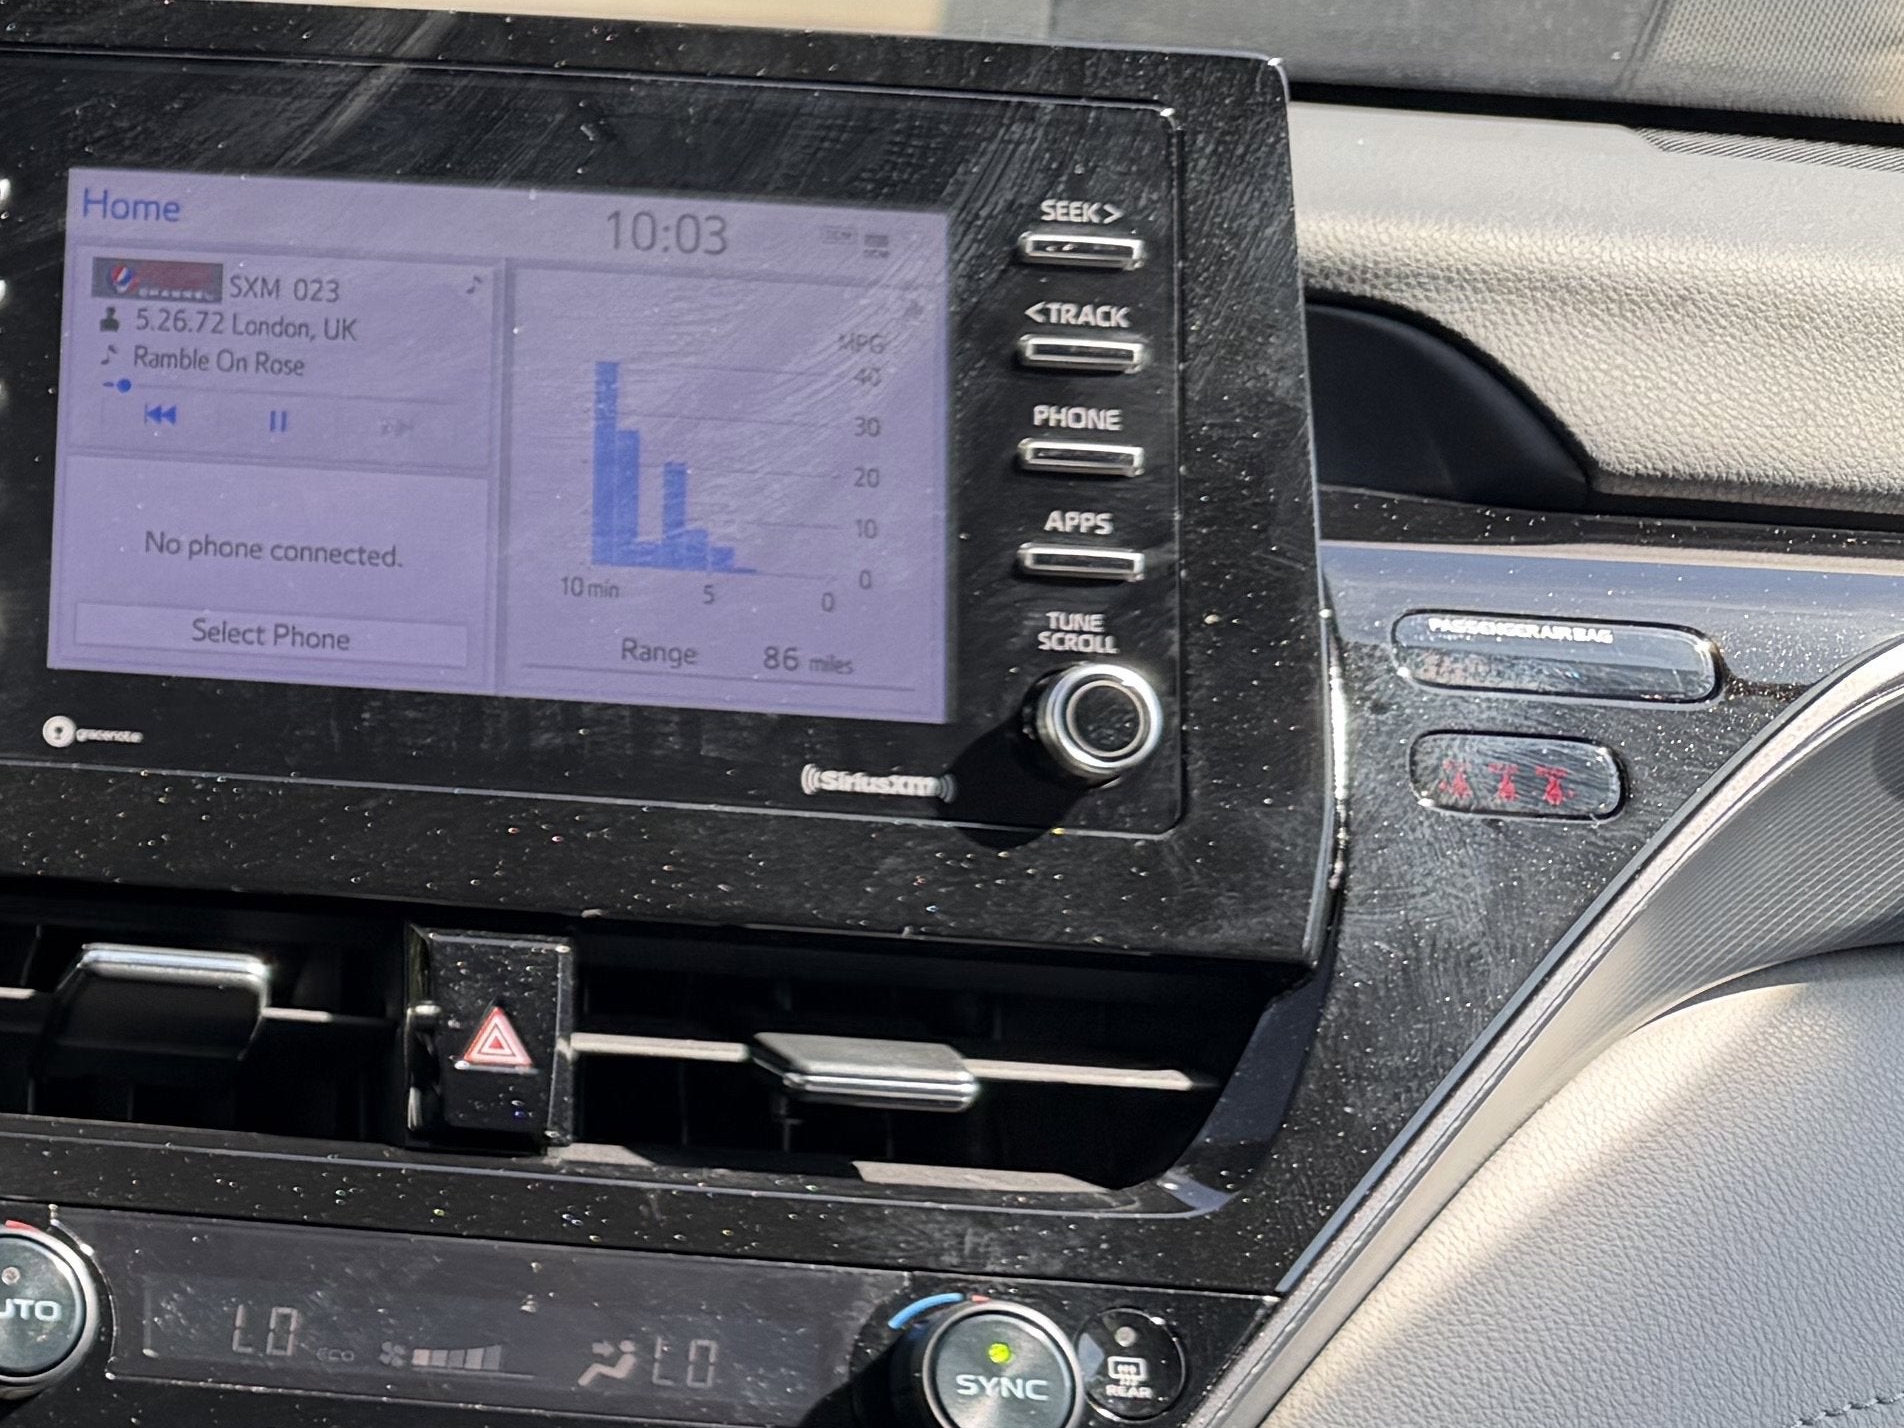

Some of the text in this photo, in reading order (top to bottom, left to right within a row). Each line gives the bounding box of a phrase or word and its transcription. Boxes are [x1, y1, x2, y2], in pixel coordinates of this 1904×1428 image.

[82, 187, 182, 223] Home
[606, 210, 730, 256] 10:03
[229, 275, 342, 304] SXM 023
[134, 306, 358, 343] 5.26.72 London, UK
[837, 332, 885, 354] MPG
[133, 344, 305, 378] Ramble On Rose
[854, 416, 881, 438] 30
[1033, 404, 1123, 431] PHONE
[853, 466, 881, 489] 20
[855, 518, 879, 540] 10
[1043, 509, 1114, 536] APPS
[144, 530, 404, 569] No phone connected.
[561, 575, 620, 599] 10 min
[858, 569, 873, 590] 0
[703, 583, 716, 606] 5
[821, 592, 836, 613] 0
[1046, 612, 1105, 632] TUNE
[192, 617, 352, 652] Select Phone
[1037, 632, 1119, 655] SCROLL
[620, 637, 854, 675] Range 86 miles
[316, 1346, 354, 1363] ECO
[956, 1374, 1049, 1401] SYNC
[1106, 1383, 1152, 1399] REAR
